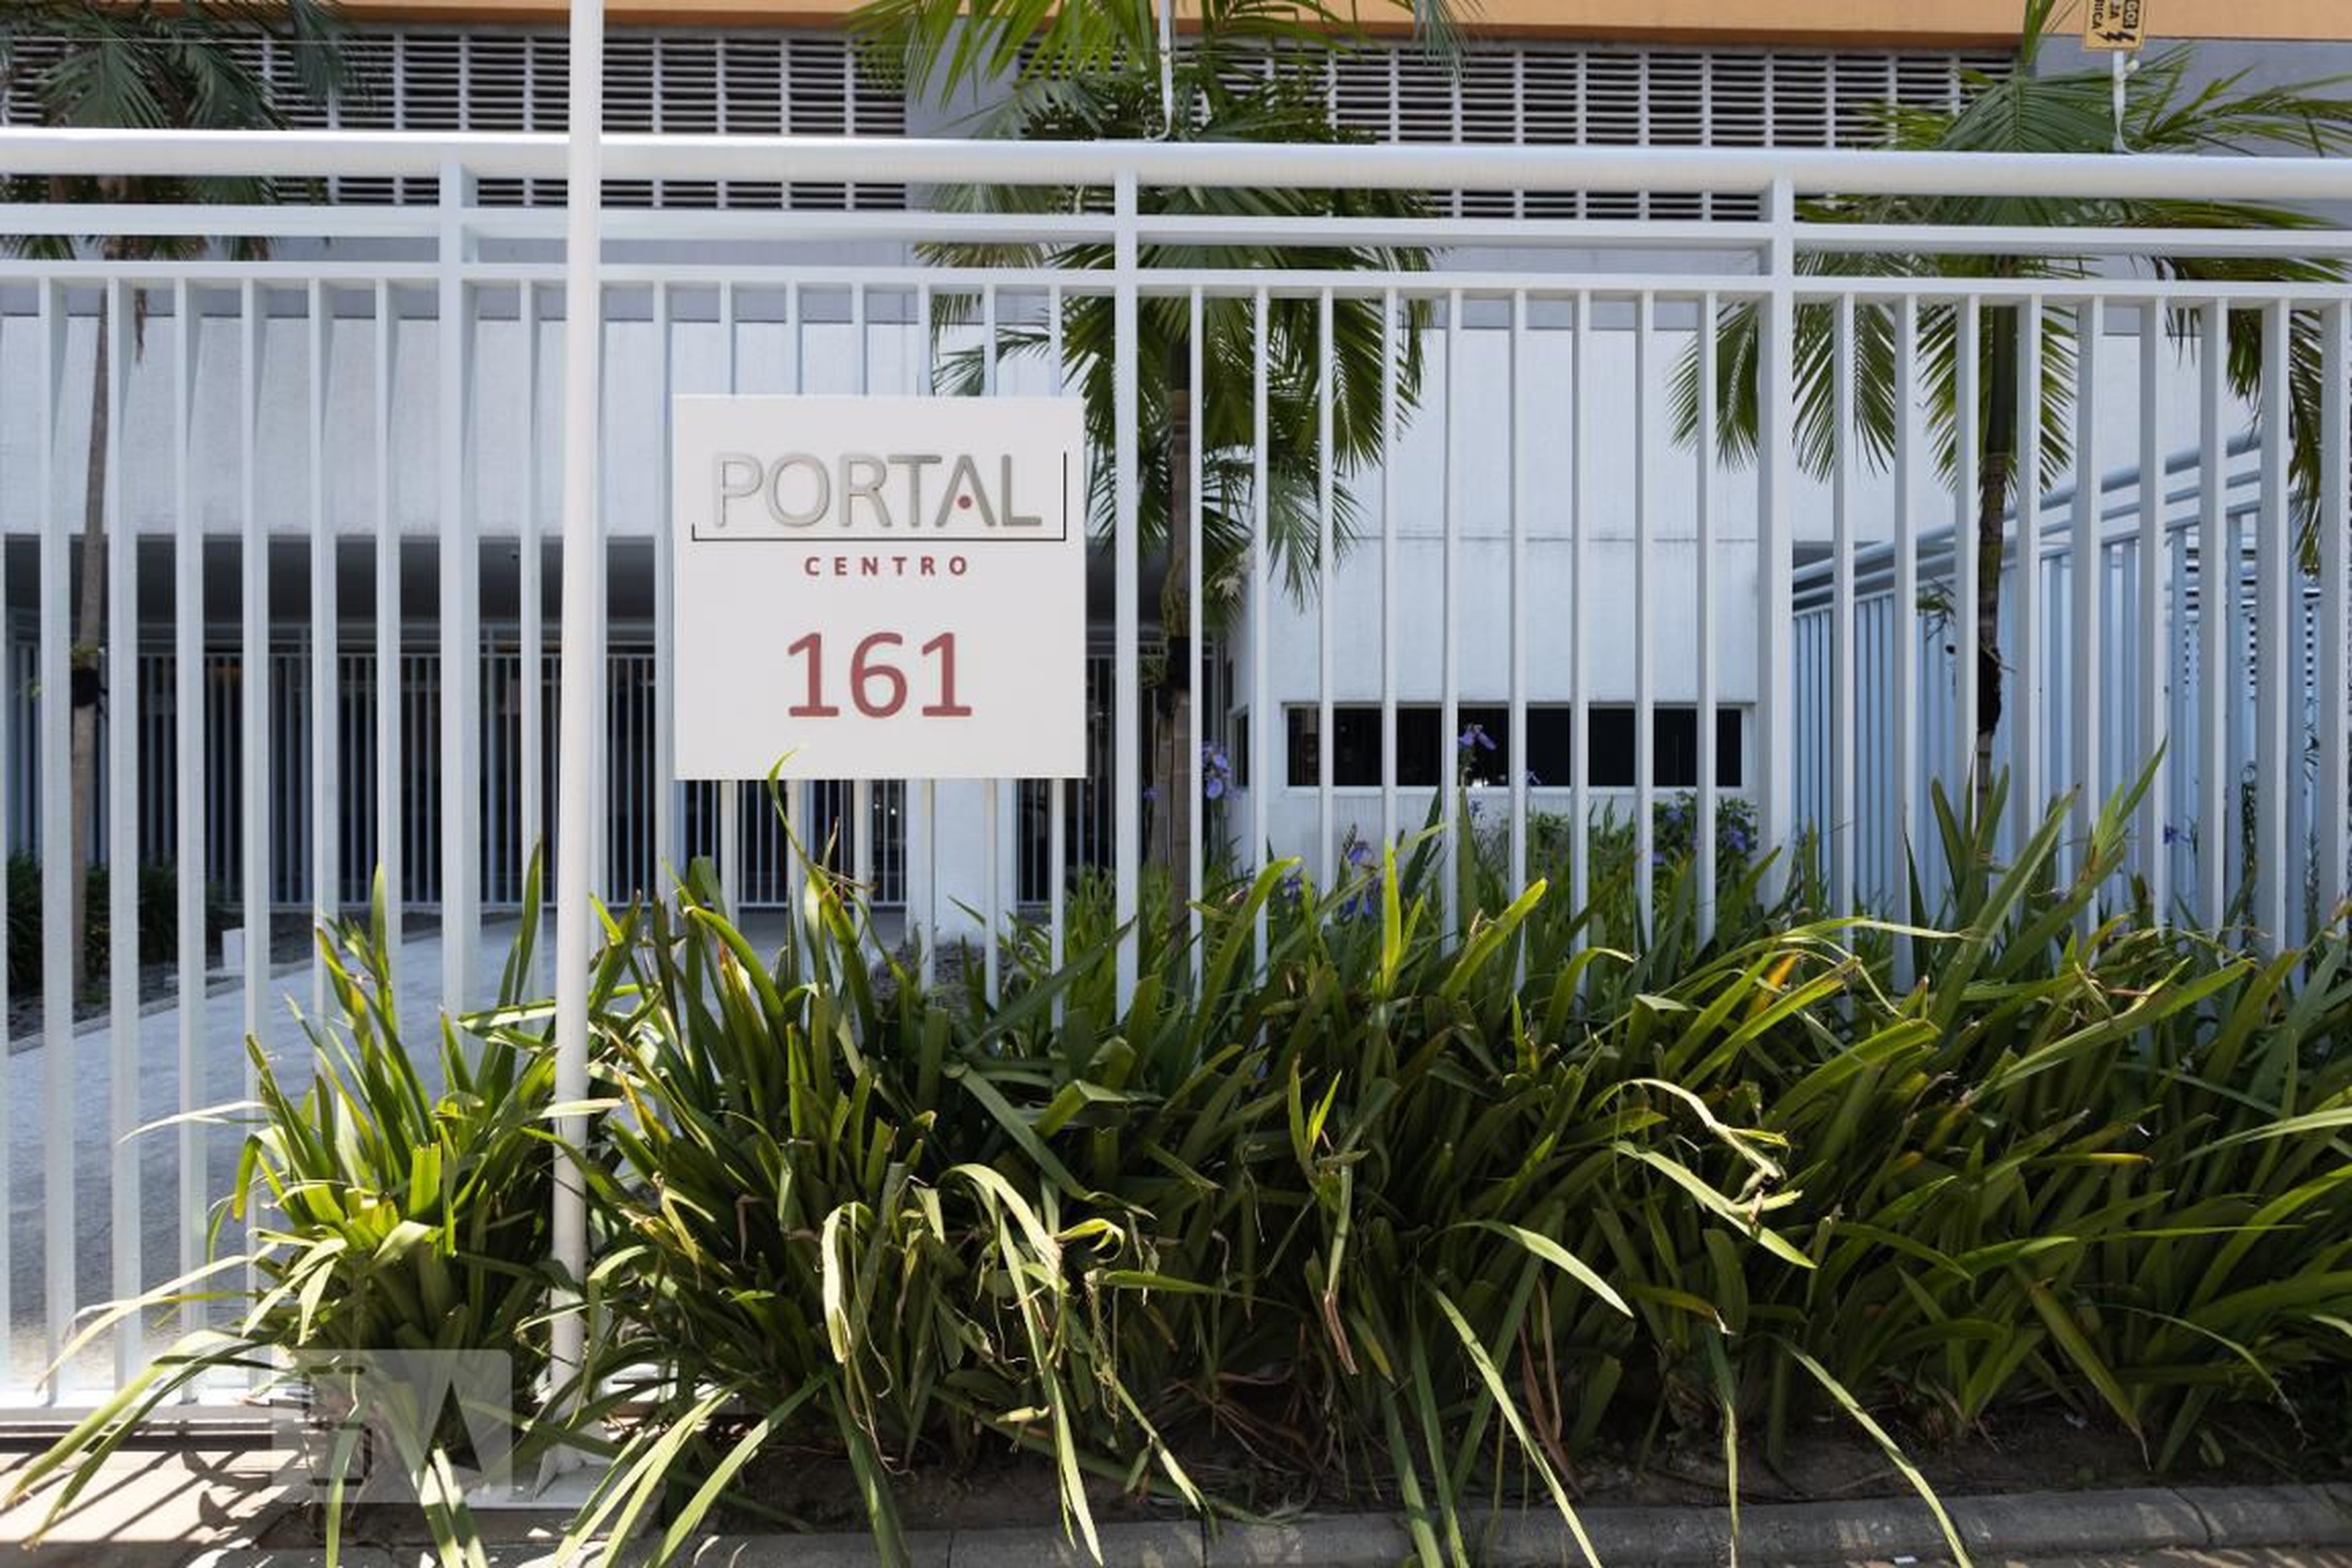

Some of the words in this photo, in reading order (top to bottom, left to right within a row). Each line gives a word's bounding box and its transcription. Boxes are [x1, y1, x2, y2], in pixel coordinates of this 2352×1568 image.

[715, 453, 1042, 528] PORTAL
[804, 555, 968, 576] CENTRO
[787, 631, 973, 718] 161
